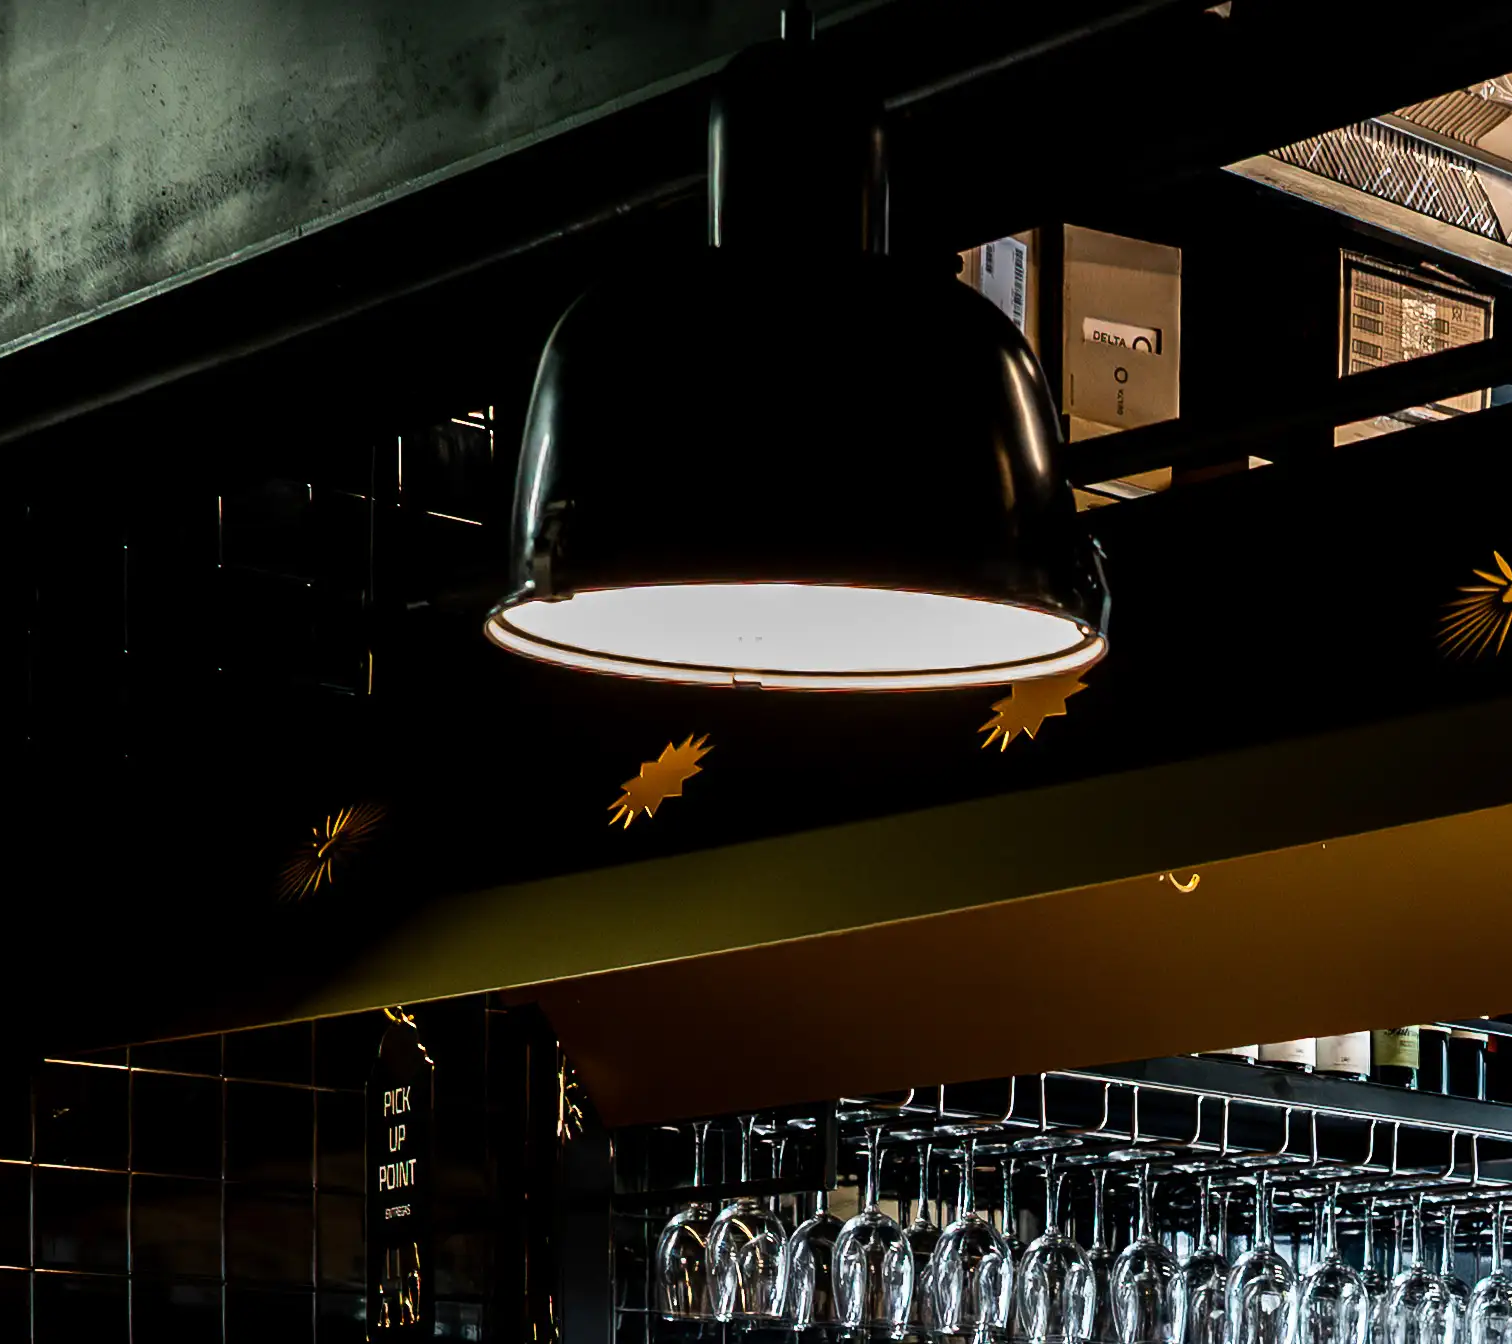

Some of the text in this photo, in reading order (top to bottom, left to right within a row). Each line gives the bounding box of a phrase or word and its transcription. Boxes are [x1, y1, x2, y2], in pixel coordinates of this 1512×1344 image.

[1092, 330, 1127, 349] DELTA
[383, 1085, 411, 1117] PICK
[389, 1124, 406, 1153] UP
[379, 1158, 417, 1192] POINT
